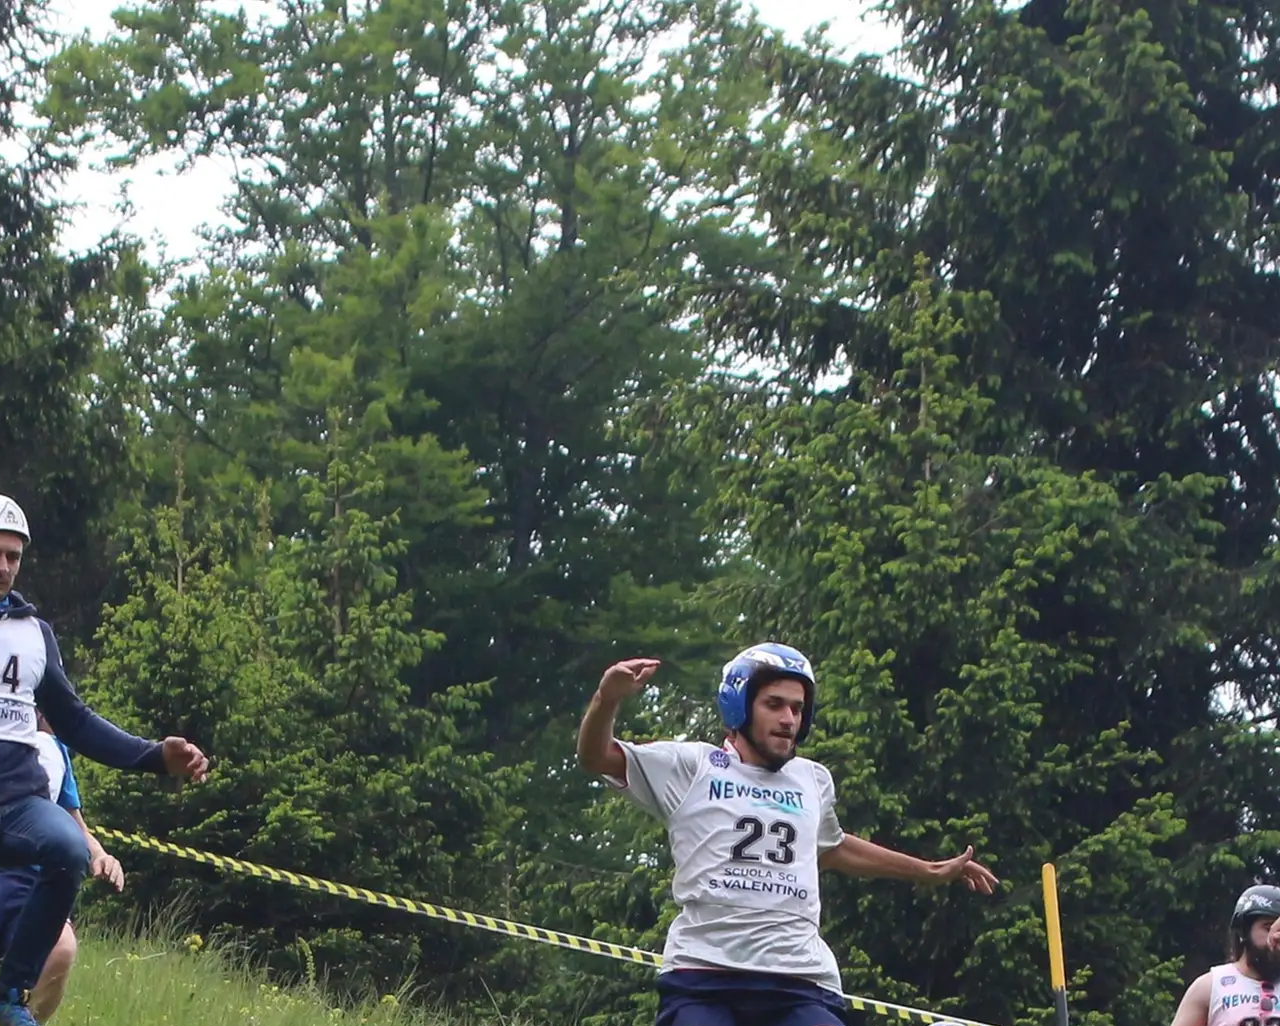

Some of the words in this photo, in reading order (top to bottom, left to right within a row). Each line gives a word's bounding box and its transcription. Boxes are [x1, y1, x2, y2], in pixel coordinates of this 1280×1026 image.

[708, 780, 804, 809] NEWSPORT
[730, 815, 797, 865] 23
[724, 867, 772, 878] SCUOLA
[778, 872, 797, 883] SCI
[708, 879, 808, 900] S.VALENTINO
